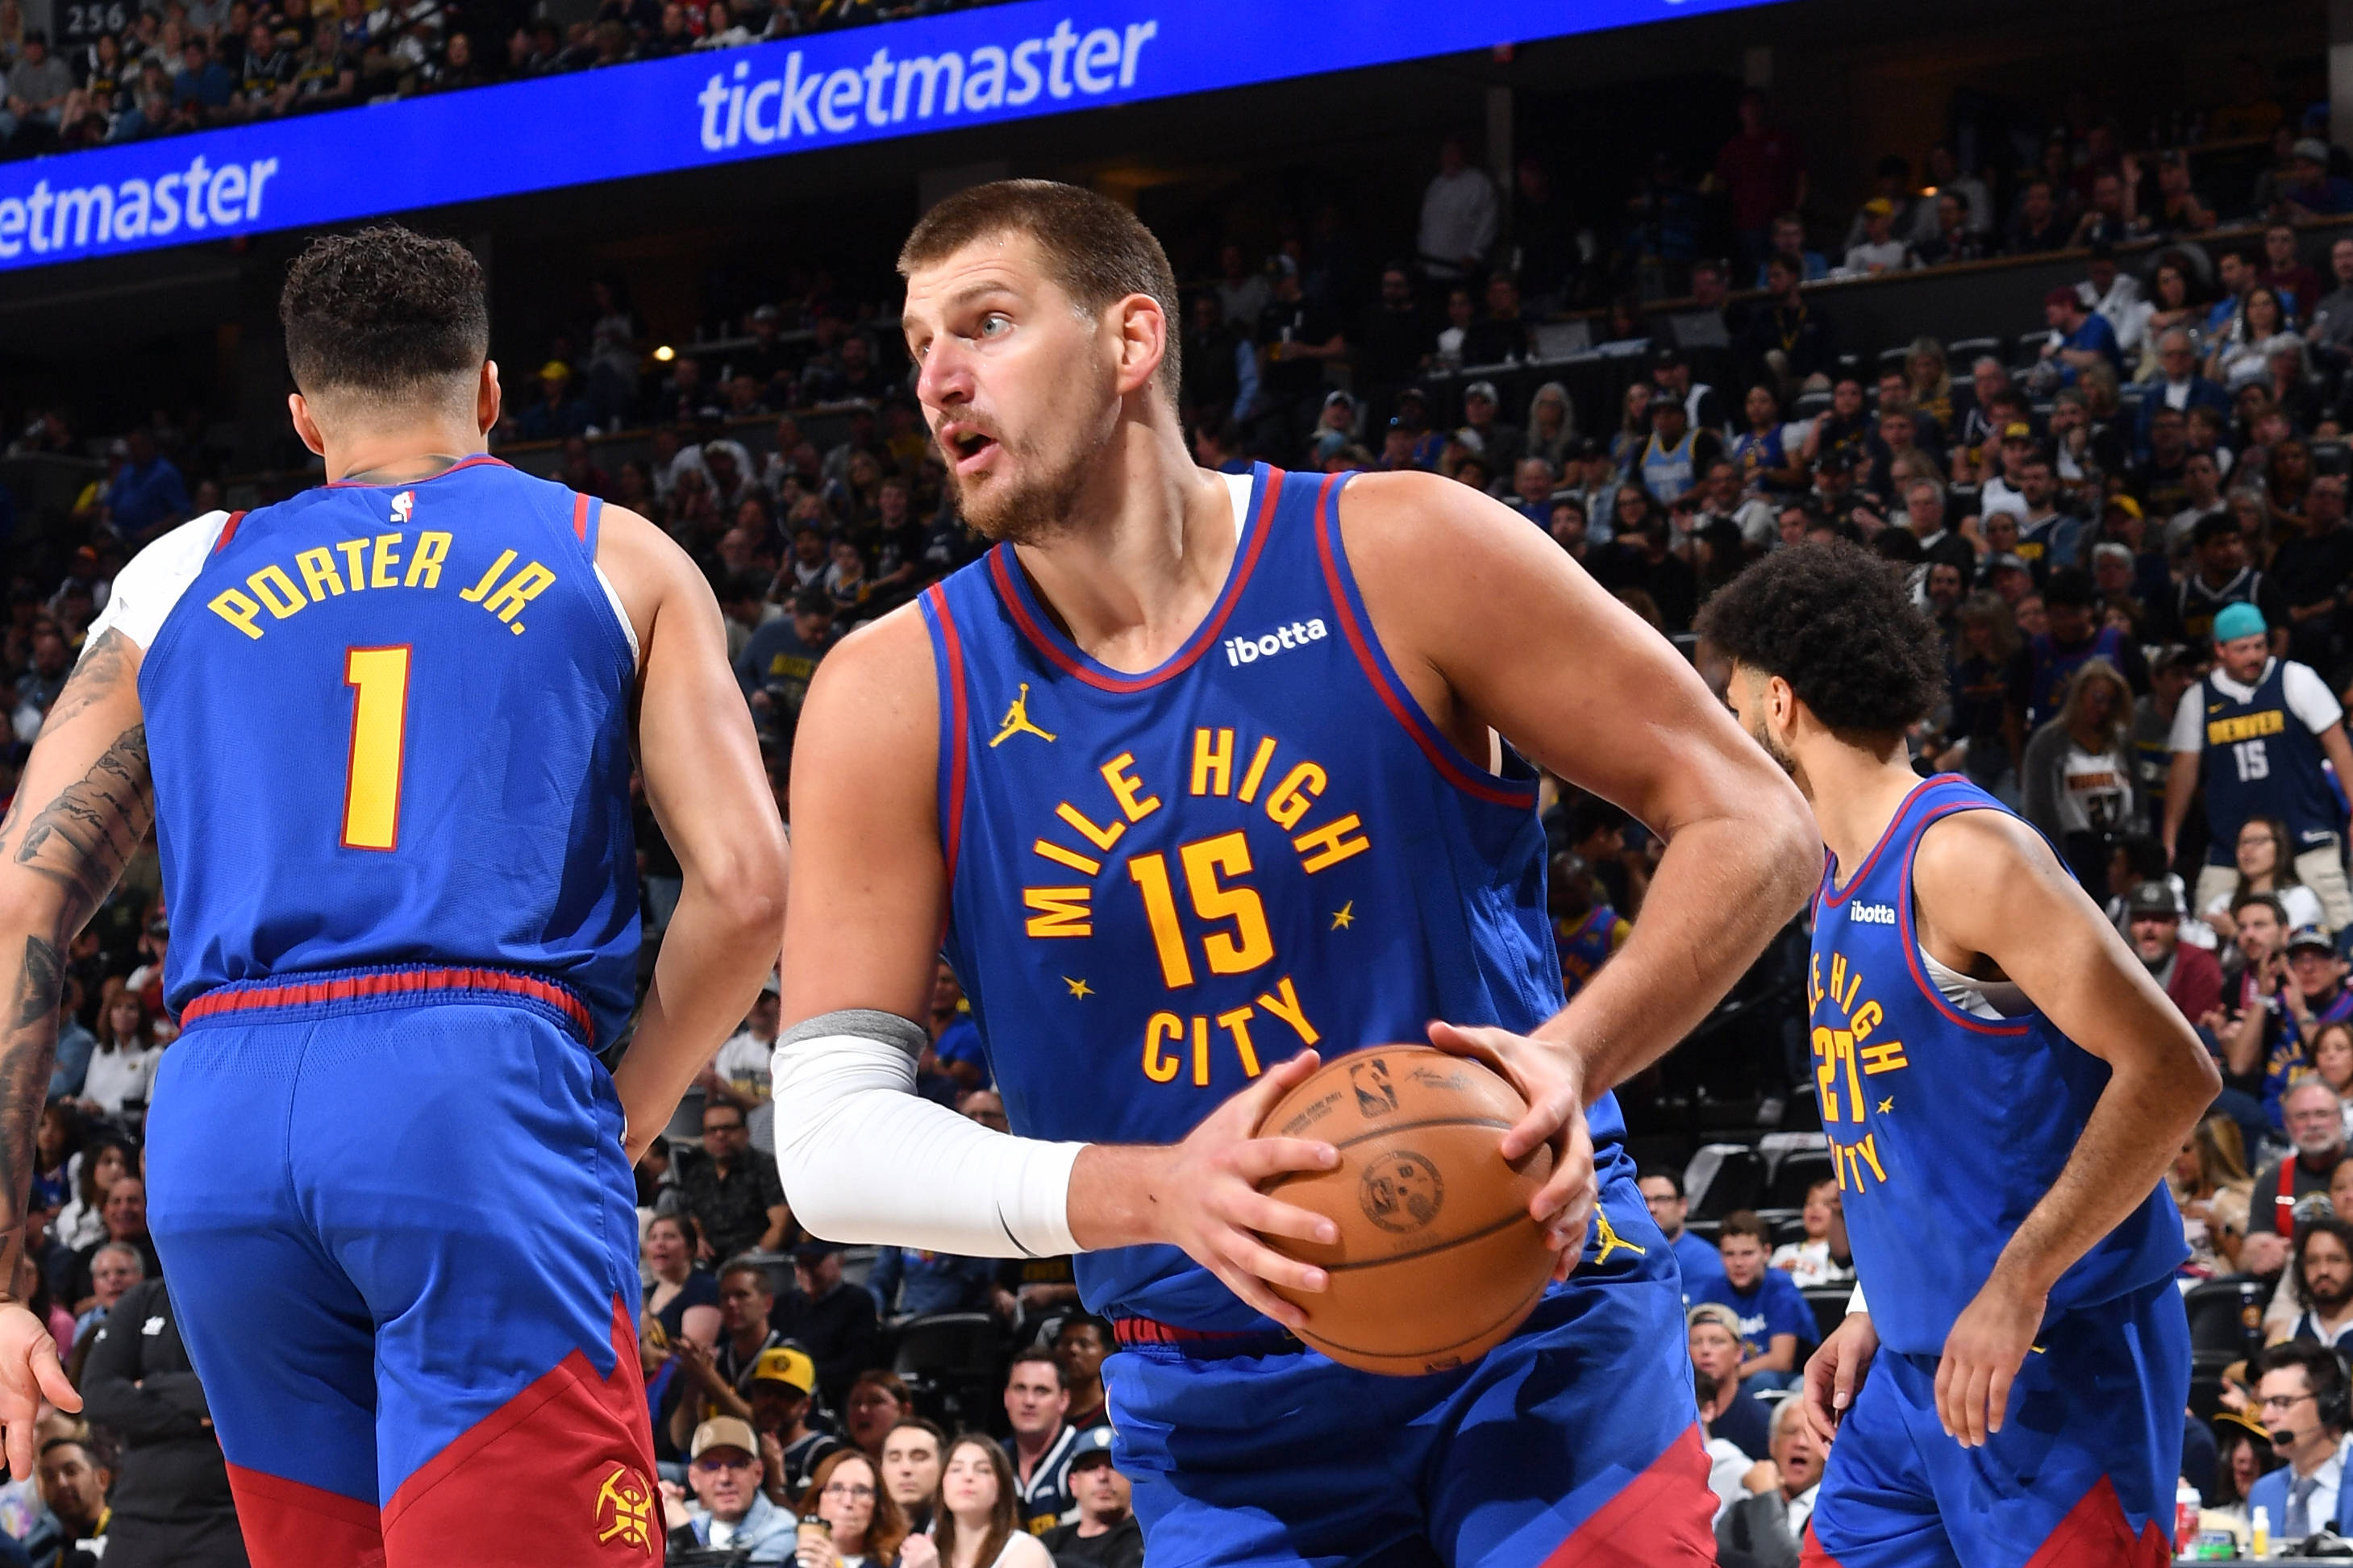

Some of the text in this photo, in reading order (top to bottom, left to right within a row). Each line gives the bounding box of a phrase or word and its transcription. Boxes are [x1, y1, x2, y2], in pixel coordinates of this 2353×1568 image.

[67, 3, 127, 33] 256
[698, 19, 1156, 151] ticketmaster
[0, 155, 277, 257] etmaster
[208, 530, 556, 640] PORTER JR.
[1223, 617, 1329, 668] ibotta
[339, 643, 413, 852] 1
[2232, 738, 2270, 782] 15
[1022, 726, 1372, 938] MILE HIGH
[1128, 829, 1276, 990] 15
[1850, 900, 1896, 925] ibotta
[1141, 975, 1321, 1087] CITY
[1830, 951, 1909, 1075] HIGH
[1811, 1025, 1866, 1124] 27
